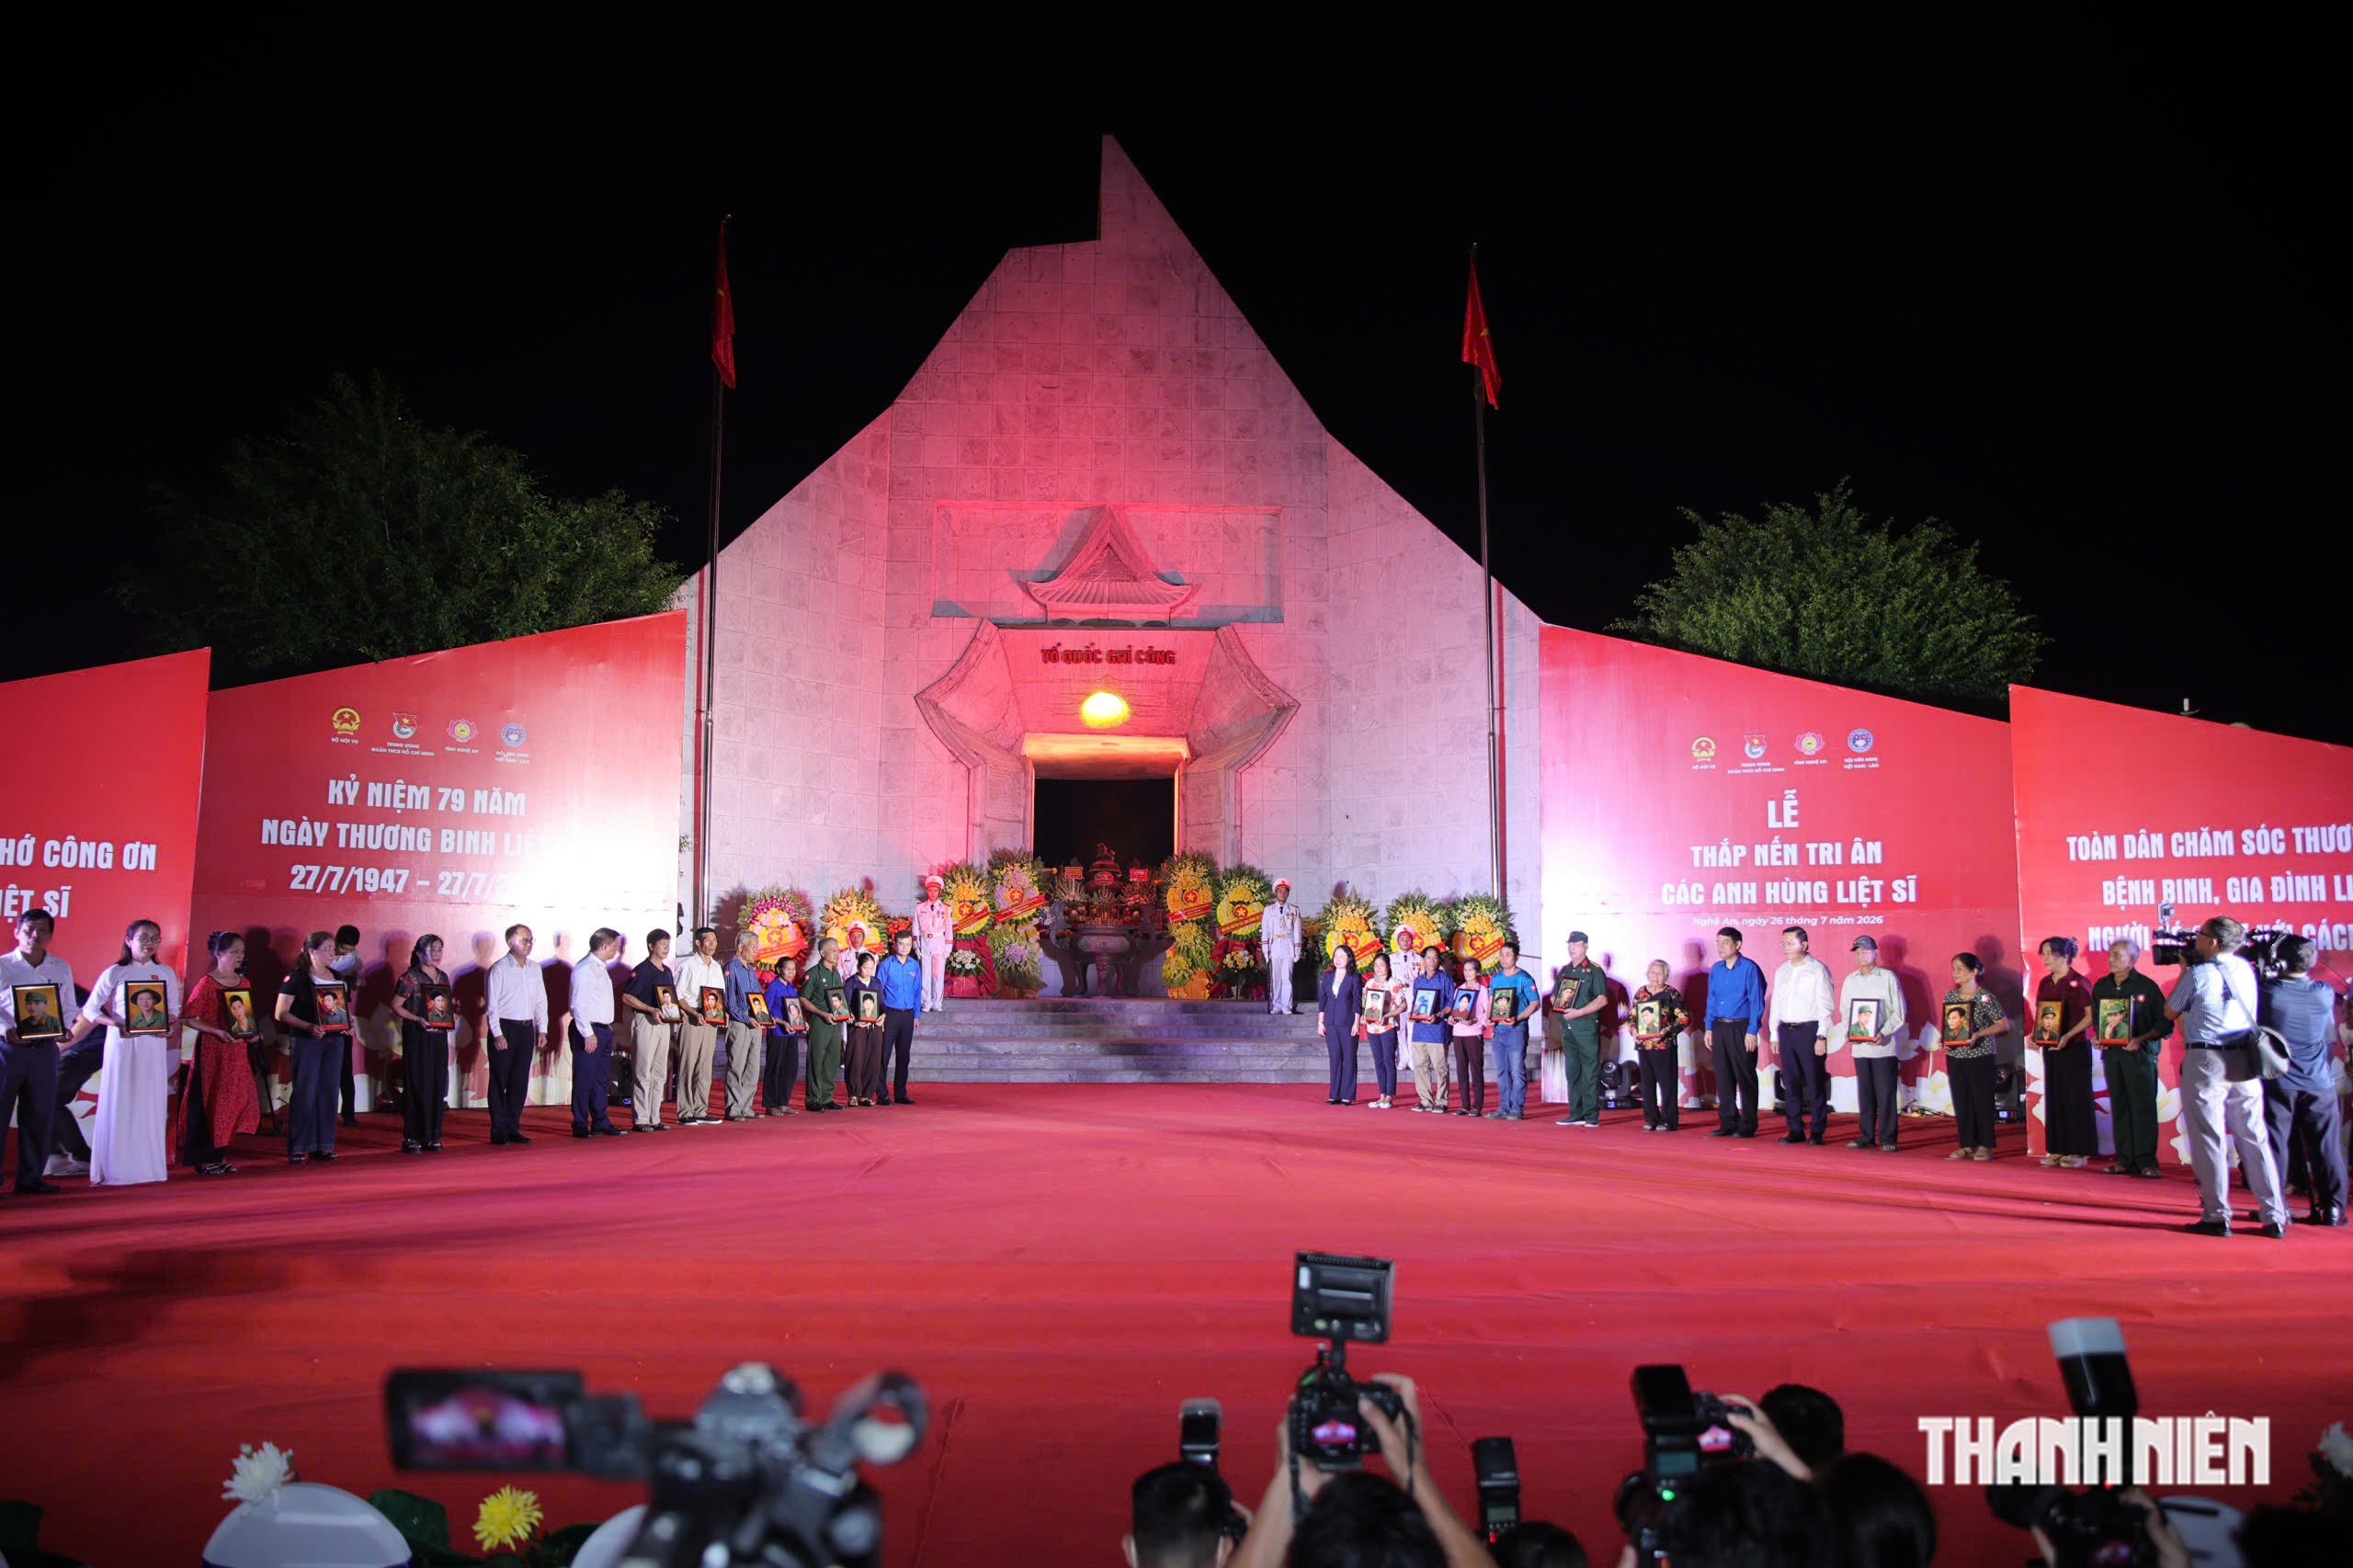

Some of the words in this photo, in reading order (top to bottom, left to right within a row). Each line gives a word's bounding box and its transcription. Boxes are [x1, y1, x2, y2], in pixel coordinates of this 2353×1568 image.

[1063, 642, 1102, 665] QUỐC
[1134, 645, 1176, 665] CÔNG
[327, 773, 359, 806] KỶ
[367, 778, 430, 814] NIỆM
[438, 787, 465, 812] 79
[473, 786, 526, 816] NĂM
[1768, 789, 1799, 829] LỄ
[261, 815, 329, 847] NGÀY
[336, 823, 432, 853] THƯƠNG
[440, 828, 496, 855] BINH
[1690, 837, 1746, 868] THẮP
[1754, 835, 1799, 866] NẾN
[1805, 842, 1843, 866] TRI
[1850, 836, 1882, 864] ÂN
[2066, 831, 2117, 861] TOÀN
[2123, 828, 2165, 859] DÂN
[2170, 826, 2234, 858] CHĂM
[2241, 824, 2286, 856] SÓC
[43, 835, 115, 869] CÔNG
[122, 841, 157, 870] ƠN
[289, 864, 410, 895] 27/7/1947
[1661, 879, 1705, 905] CÁC
[1711, 881, 1757, 904] ANH
[1765, 878, 1828, 904] HÙNG
[1836, 875, 1884, 908] LIỆT
[1892, 874, 1917, 903] SĨ
[2102, 875, 2155, 911] BỆNH
[2161, 877, 2221, 905] BINH,
[2225, 876, 2265, 903] GIA
[2270, 870, 2327, 903] ĐÌNH
[42, 885, 73, 918] SĨ
[1693, 916, 1720, 926] Nghệ
[1742, 916, 1769, 926] ngày
[1770, 916, 1783, 925] 26
[1785, 915, 1817, 926] tháng
[1820, 916, 1827, 925] 7
[1829, 915, 1854, 925] năm
[1857, 915, 1883, 925] 2026
